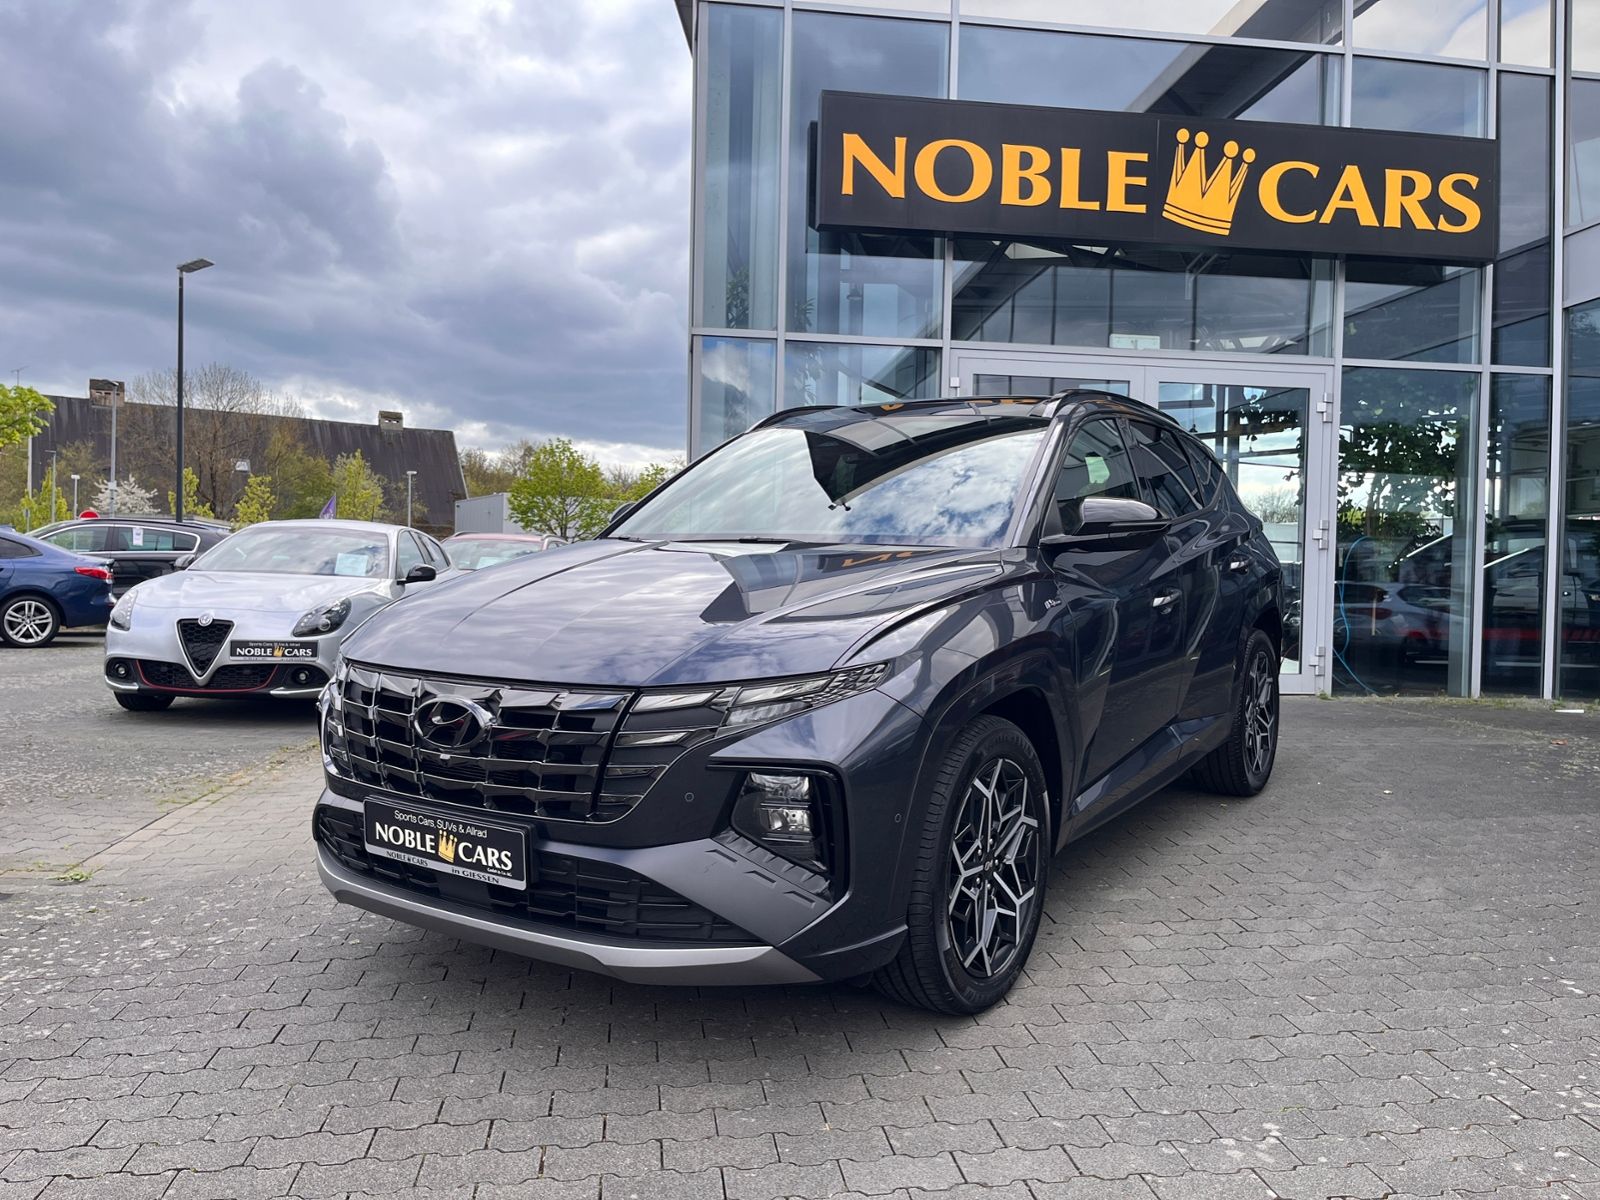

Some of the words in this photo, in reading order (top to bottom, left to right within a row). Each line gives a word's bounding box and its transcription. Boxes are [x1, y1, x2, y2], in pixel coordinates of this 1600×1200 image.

[841, 133, 1148, 214] NOBLE
[1258, 160, 1481, 234] CARS
[236, 648, 272, 656] NOBLE
[284, 648, 312, 656] CARS
[394, 810, 417, 824] Sports
[437, 818, 457, 832] SUVs
[459, 824, 465, 833] &
[466, 825, 488, 838] Allrad
[375, 821, 436, 854] NOBLE
[458, 842, 513, 871] CARS
[386, 850, 408, 862] NOBLE
[411, 856, 429, 867] CARS
[451, 867, 460, 875] in
[462, 870, 500, 884] GIESSEN
